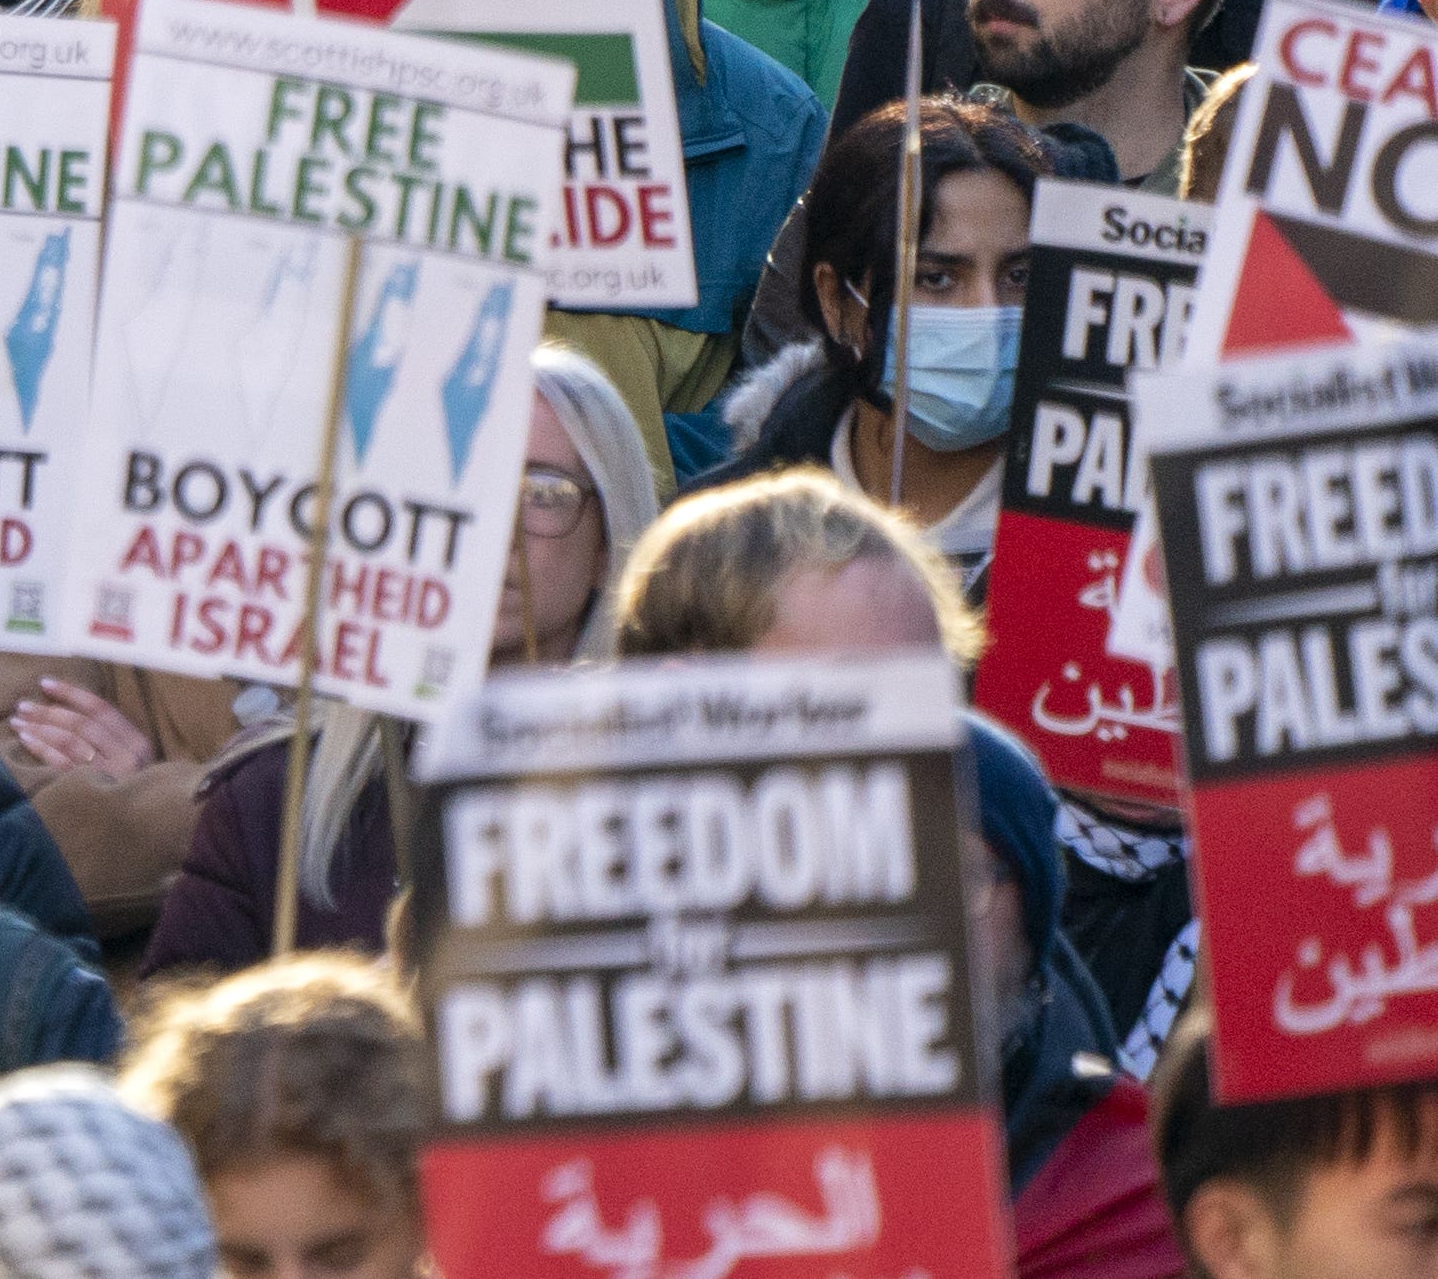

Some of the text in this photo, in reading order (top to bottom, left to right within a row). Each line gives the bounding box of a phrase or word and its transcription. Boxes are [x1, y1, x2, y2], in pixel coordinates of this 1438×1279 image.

[262, 73, 449, 173] FREE
[136, 130, 542, 268] PALESTINE
[120, 448, 476, 571] BOYCOTT
[120, 527, 454, 634] APARTHEID
[168, 590, 393, 688] ISRAEL
[445, 761, 916, 925] FREEDOM
[444, 953, 959, 1122] PALESTINE
